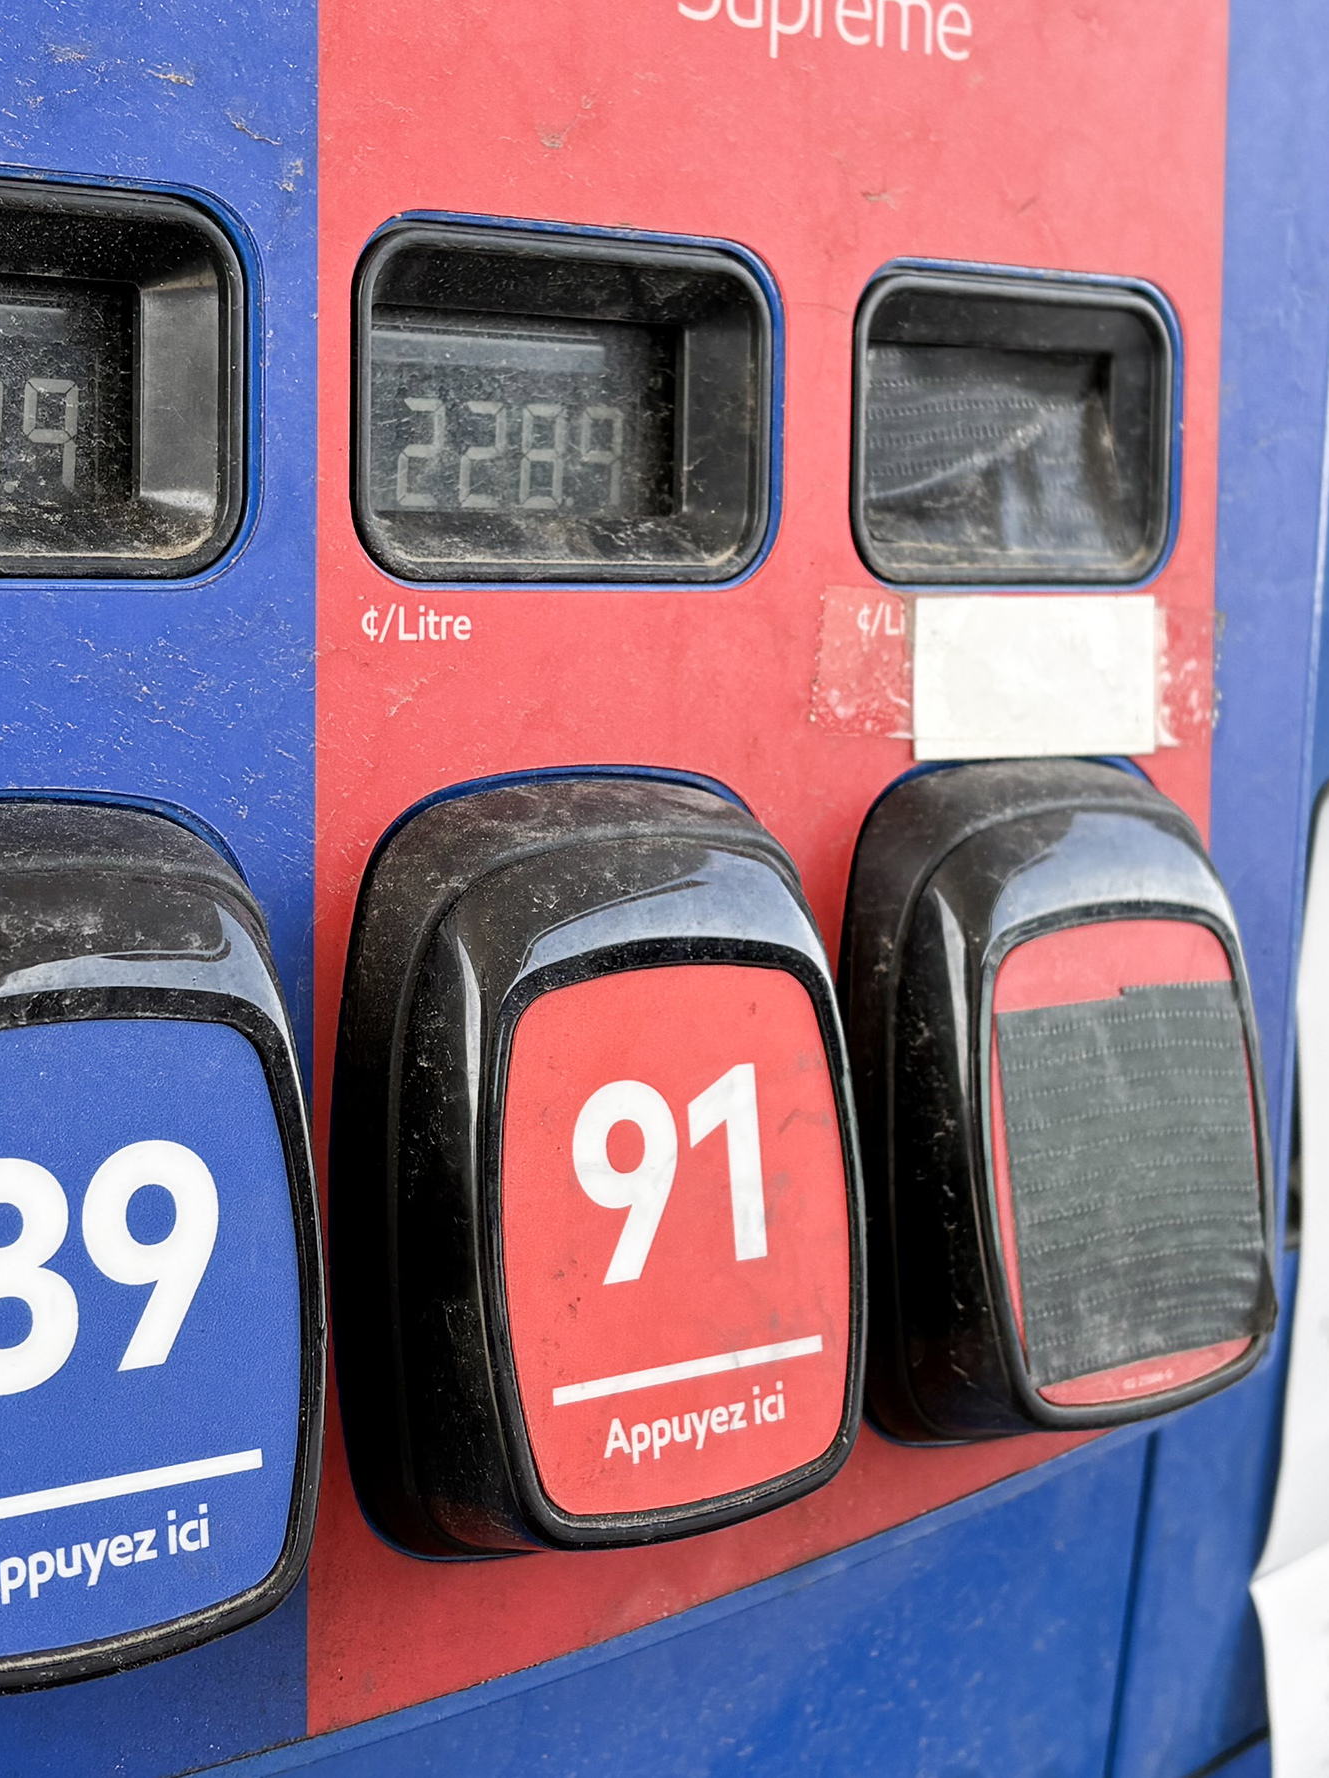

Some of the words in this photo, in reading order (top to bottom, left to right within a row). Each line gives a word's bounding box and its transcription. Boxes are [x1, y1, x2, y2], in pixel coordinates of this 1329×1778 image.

[361, 603, 472, 643] ¢/Litre
[572, 1062, 768, 1285] 91
[603, 1401, 748, 1465] Appuyez
[752, 1380, 785, 1425] ici
[167, 1503, 210, 1555] ici
